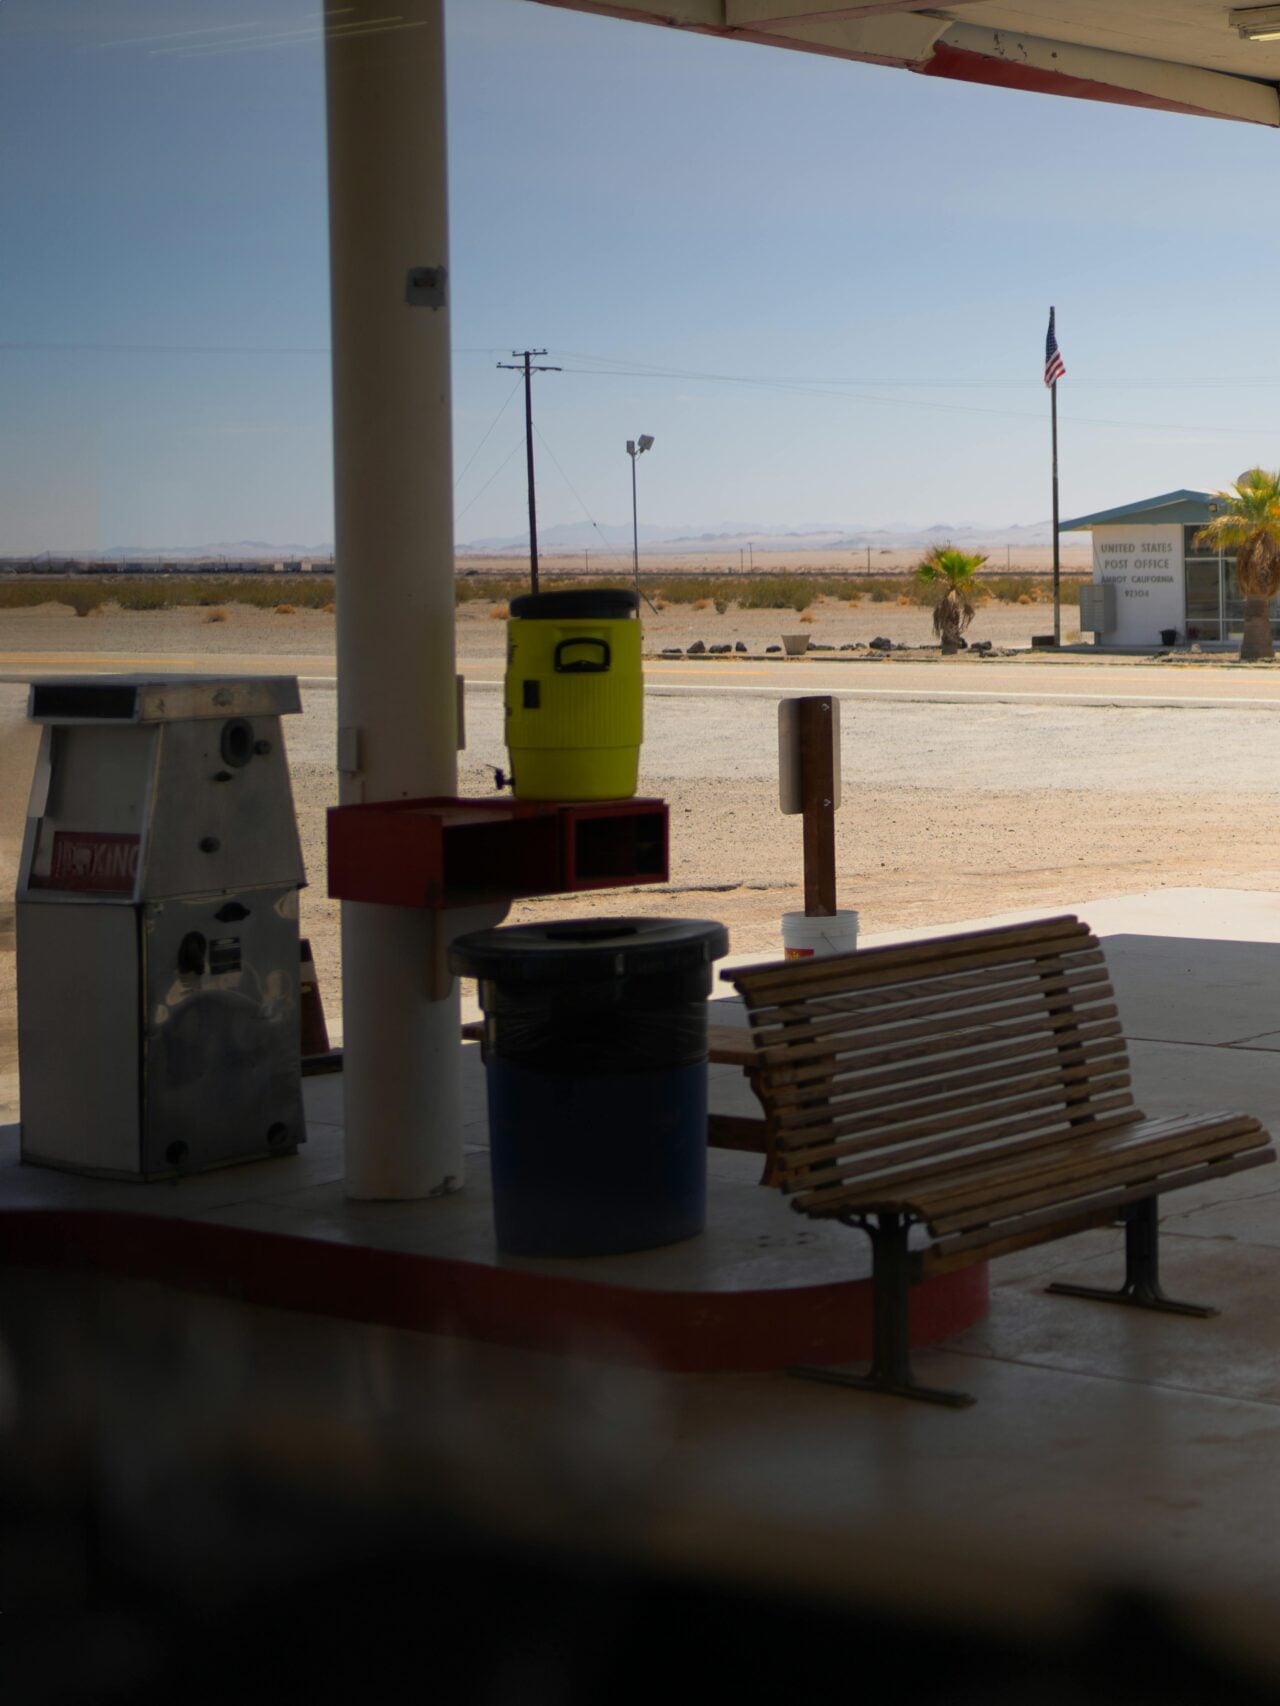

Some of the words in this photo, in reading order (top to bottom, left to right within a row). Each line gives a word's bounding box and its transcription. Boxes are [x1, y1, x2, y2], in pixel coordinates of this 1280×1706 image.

[1101, 543, 1136, 553] UNITED
[1141, 543, 1173, 553] STATES
[1104, 559, 1128, 569] POST
[1134, 559, 1169, 569] OFFICE
[1131, 575, 1174, 584] CALIFORNIA
